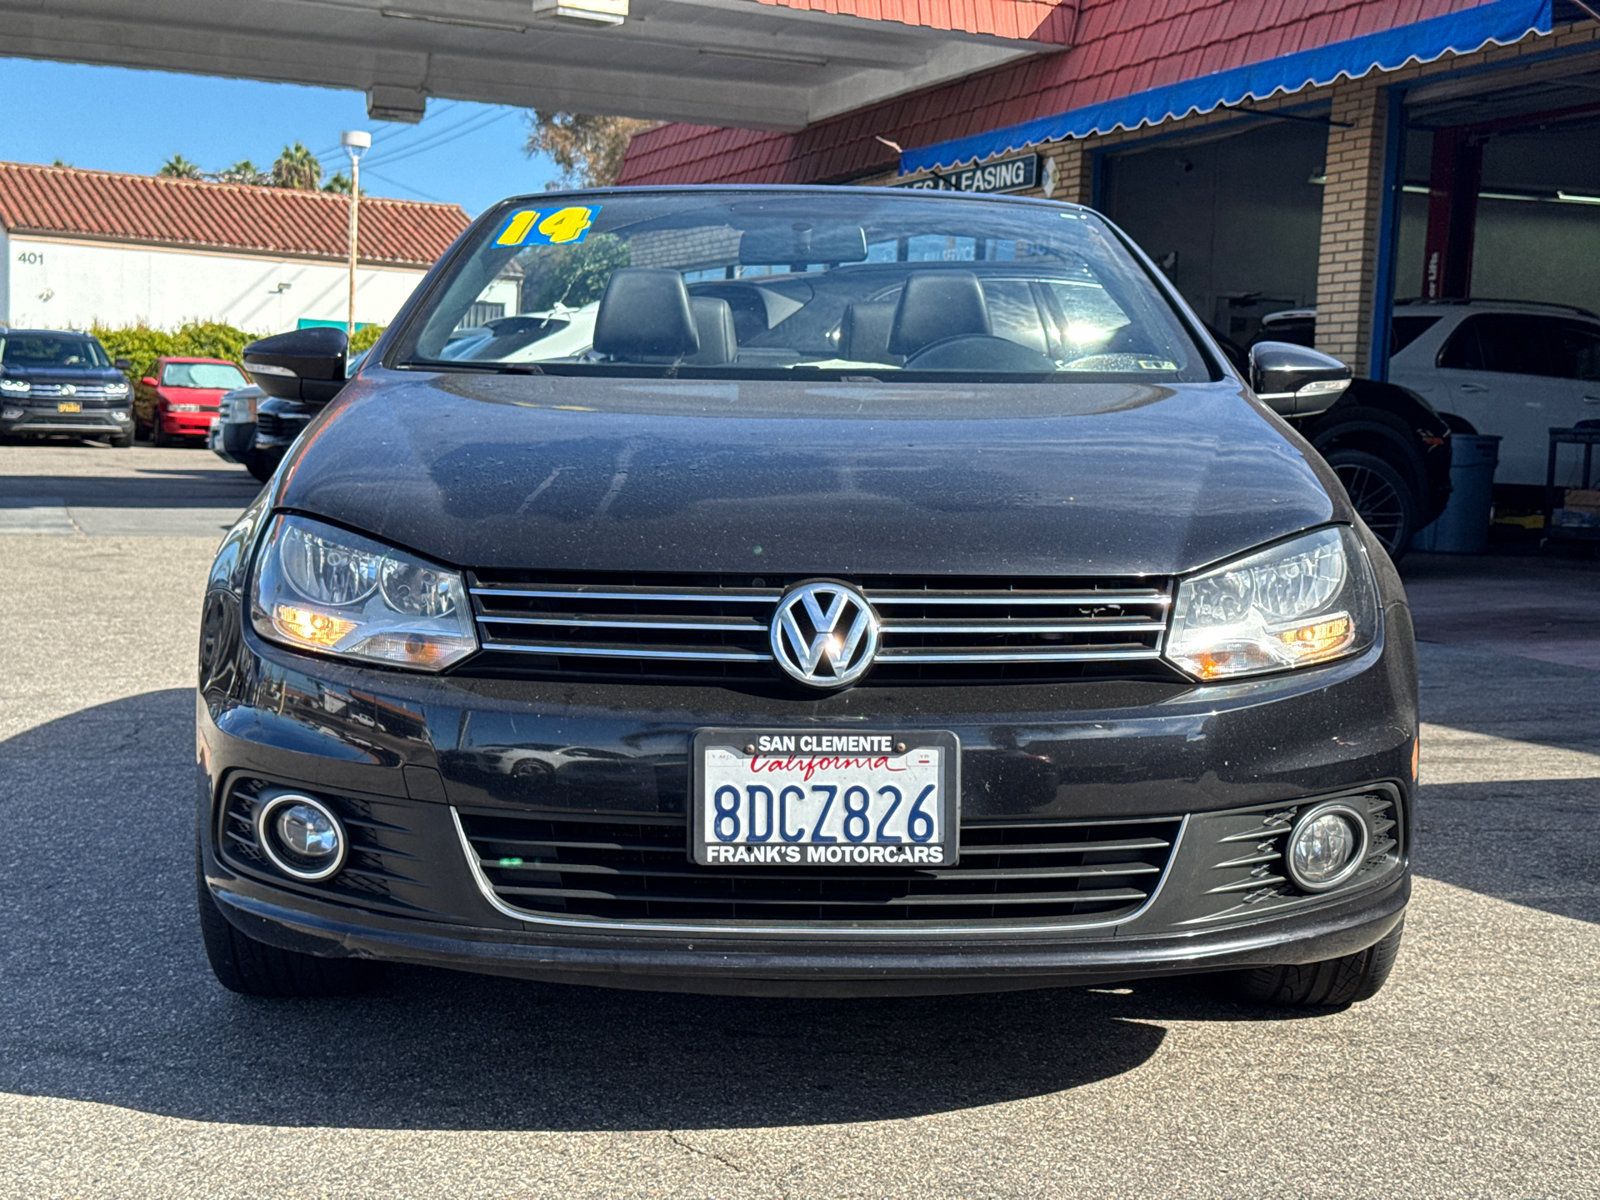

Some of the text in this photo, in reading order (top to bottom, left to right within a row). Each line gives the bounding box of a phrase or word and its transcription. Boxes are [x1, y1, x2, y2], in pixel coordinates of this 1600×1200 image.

[497, 207, 592, 245] 14
[18, 252, 44, 266] 401
[759, 735, 892, 752] SAN CLEMENTE
[750, 753, 907, 782] California
[713, 784, 936, 843] 8DCZ826
[706, 845, 944, 863] FRANK'S MOTORCARS
